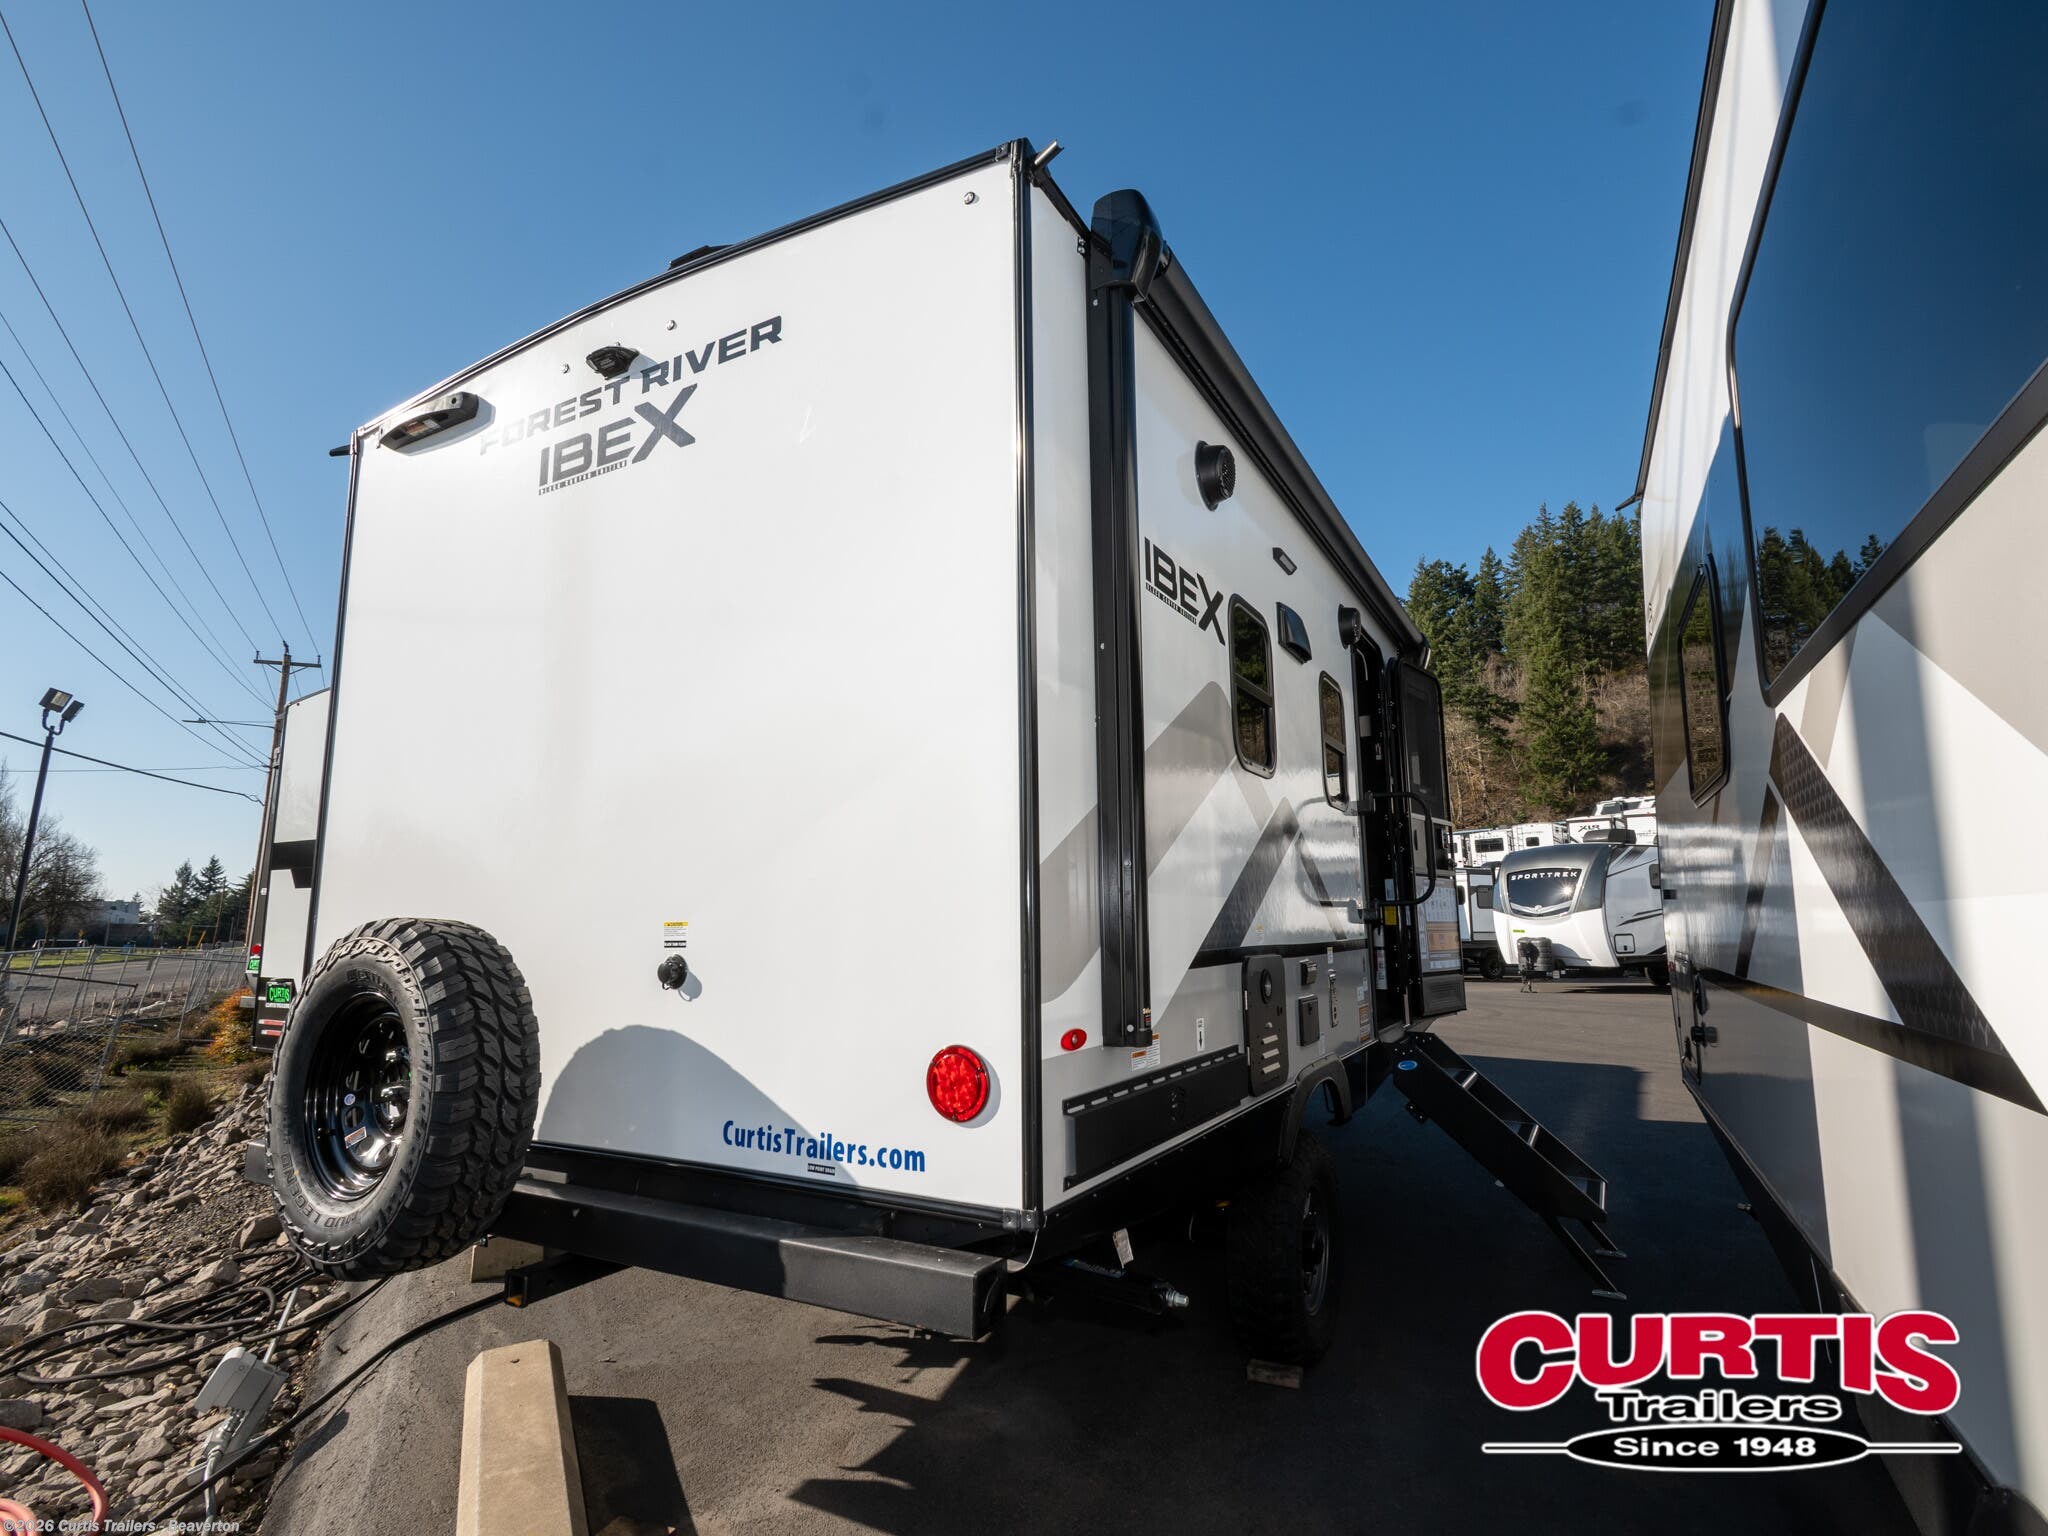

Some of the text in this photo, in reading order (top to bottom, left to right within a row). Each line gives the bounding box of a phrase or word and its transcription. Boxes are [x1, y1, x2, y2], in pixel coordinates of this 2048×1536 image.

[480, 315, 782, 456] FOREST RIVER
[538, 383, 698, 487] IBEX
[1144, 536, 1226, 647] IBEX
[1511, 871, 1578, 880] SPORTTREK
[269, 987, 290, 1002] CURTIS
[722, 1120, 926, 1173] CurtisTrailers.com
